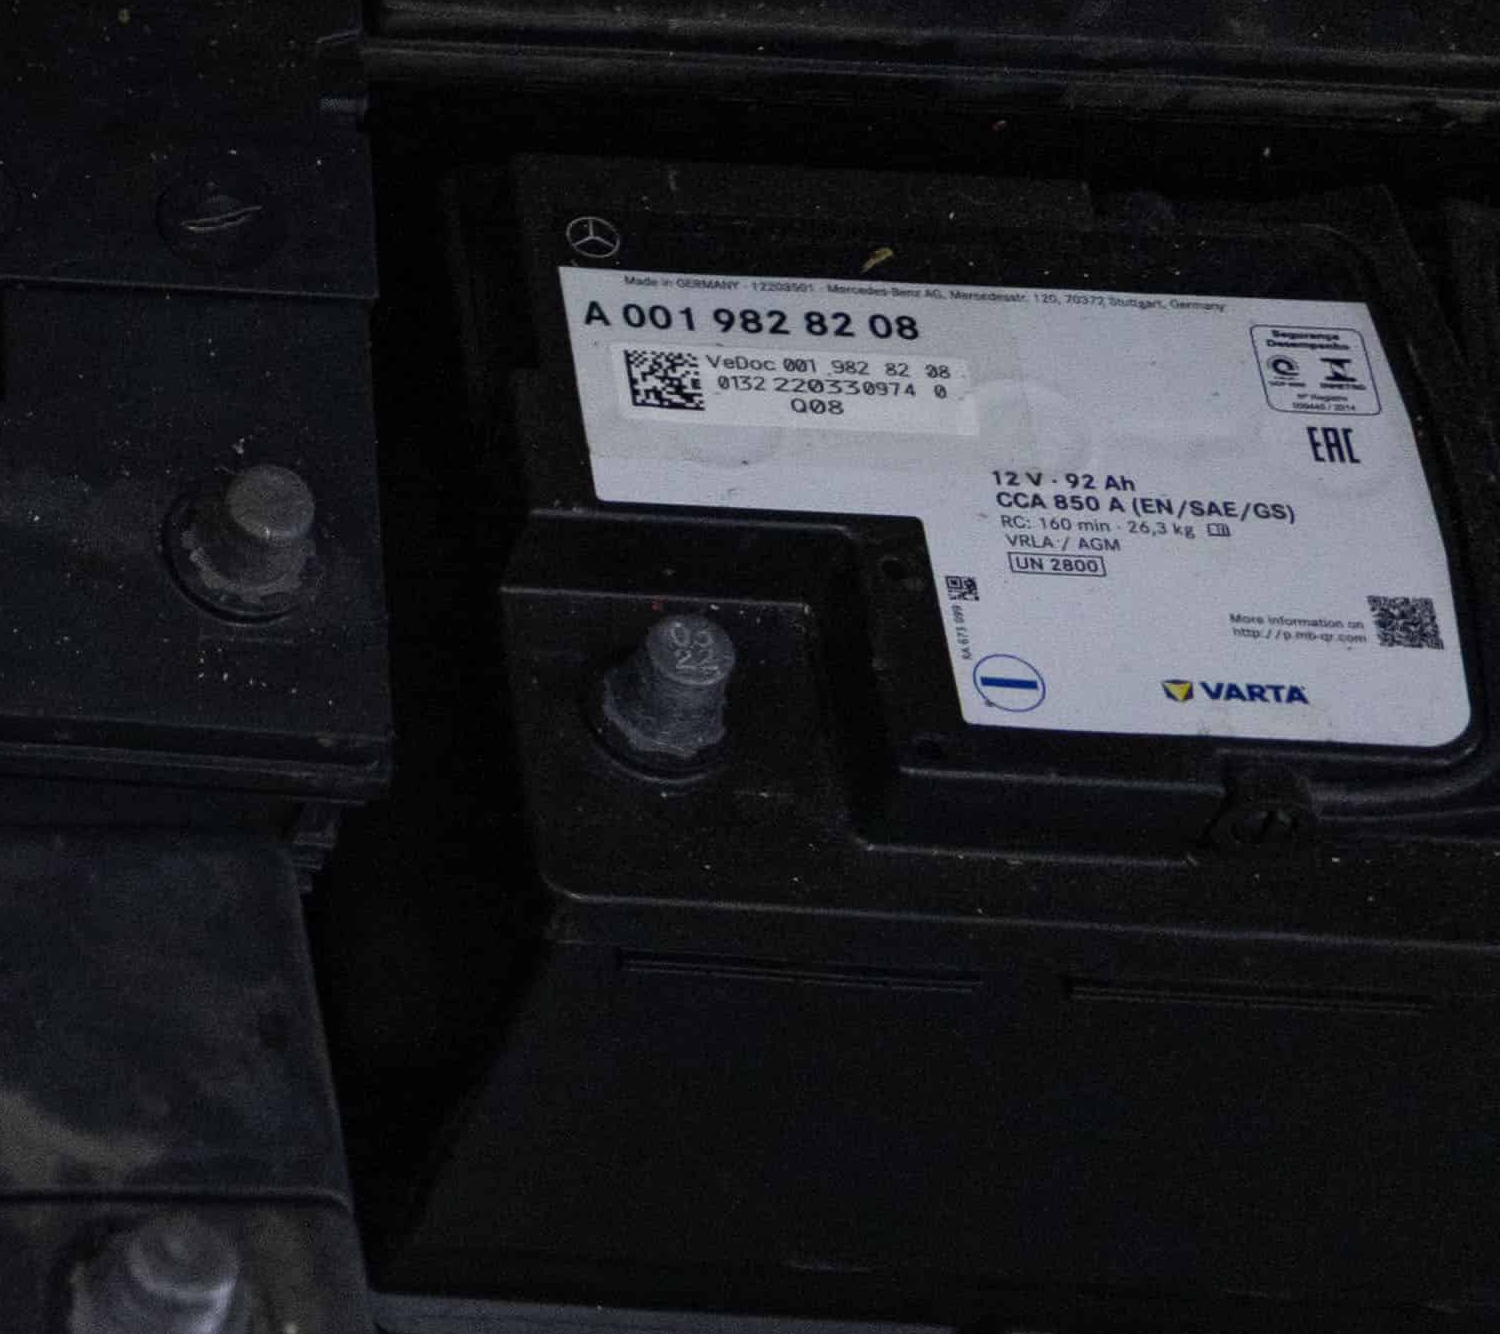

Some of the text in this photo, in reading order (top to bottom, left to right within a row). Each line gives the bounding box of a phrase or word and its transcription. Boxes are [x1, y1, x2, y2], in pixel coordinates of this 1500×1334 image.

[624, 275, 659, 288] Made
[661, 277, 674, 289] in
[676, 279, 739, 292] GERMANY
[583, 302, 919, 341] A 001 982 82 08
[705, 354, 952, 380] VeDoc 001 982 82 08
[717, 375, 948, 399] 0132 220330974 0
[1306, 426, 1361, 464] EAC
[991, 470, 1136, 492] 12 V 92 Ah
[996, 492, 1047, 511] CCA
[1054, 494, 1101, 512] 850
[1108, 496, 1126, 513] A
[1000, 515, 1196, 539] RC: 160 min 26,3 kg
[1006, 534, 1052, 549] VRLA
[1078, 536, 1121, 552] AGM
[1013, 555, 1099, 574] UN 2800
[1229, 613, 1264, 625] More
[1268, 615, 1343, 630] information
[1200, 681, 1310, 705] VARTA
